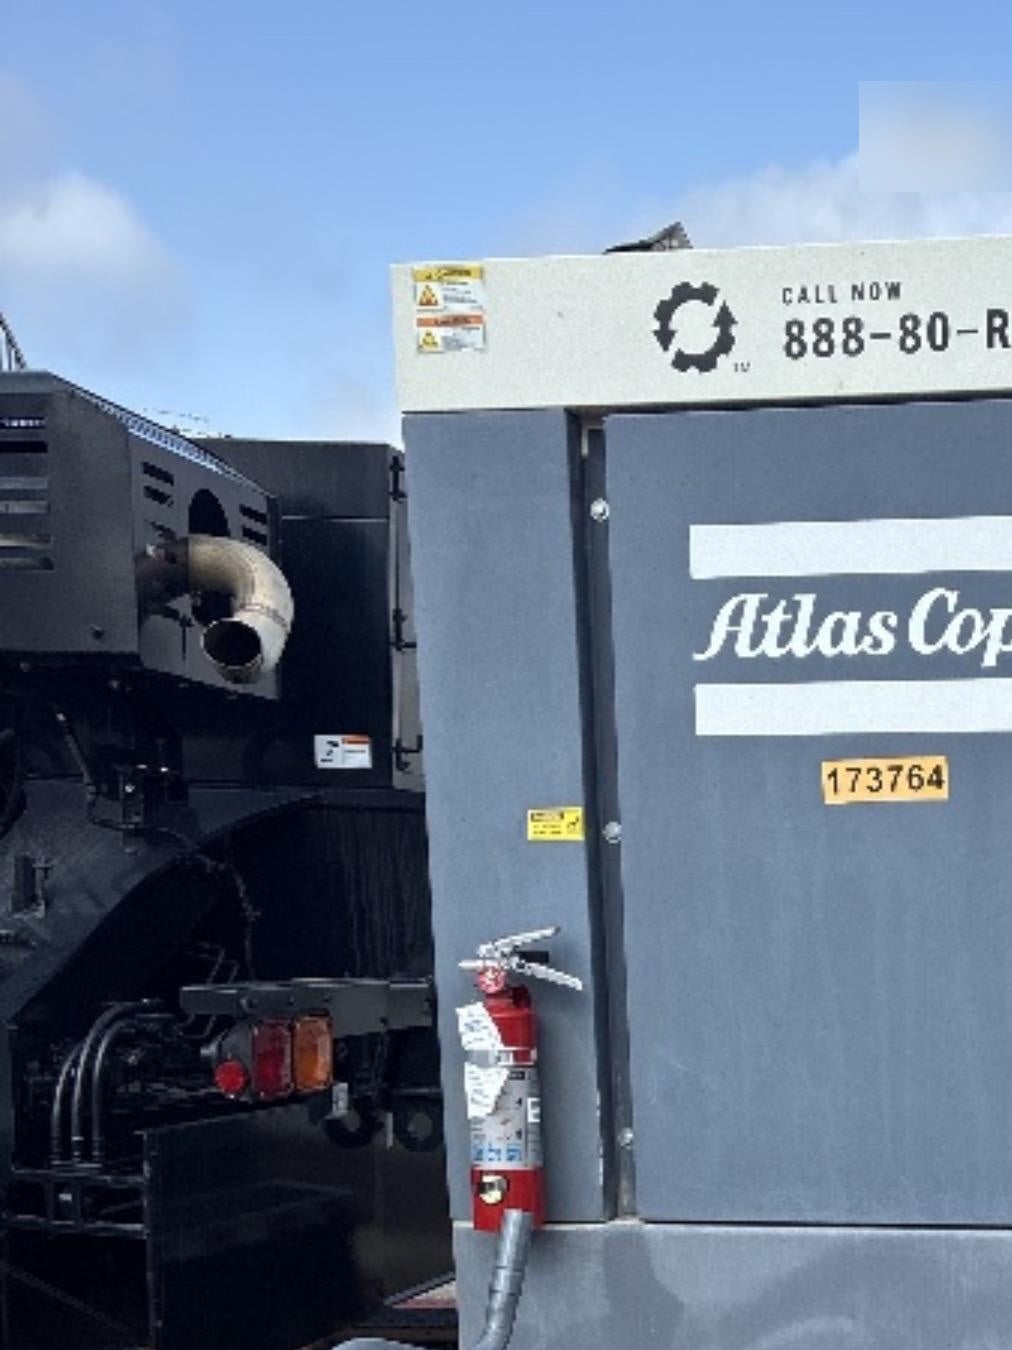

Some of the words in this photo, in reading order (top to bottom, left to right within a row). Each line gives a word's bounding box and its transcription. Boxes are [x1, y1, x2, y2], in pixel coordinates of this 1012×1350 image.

[781, 284, 838, 305] CALL
[851, 281, 902, 301] NOW
[693, 592, 898, 661] Atlas
[826, 764, 945, 795] 173764
